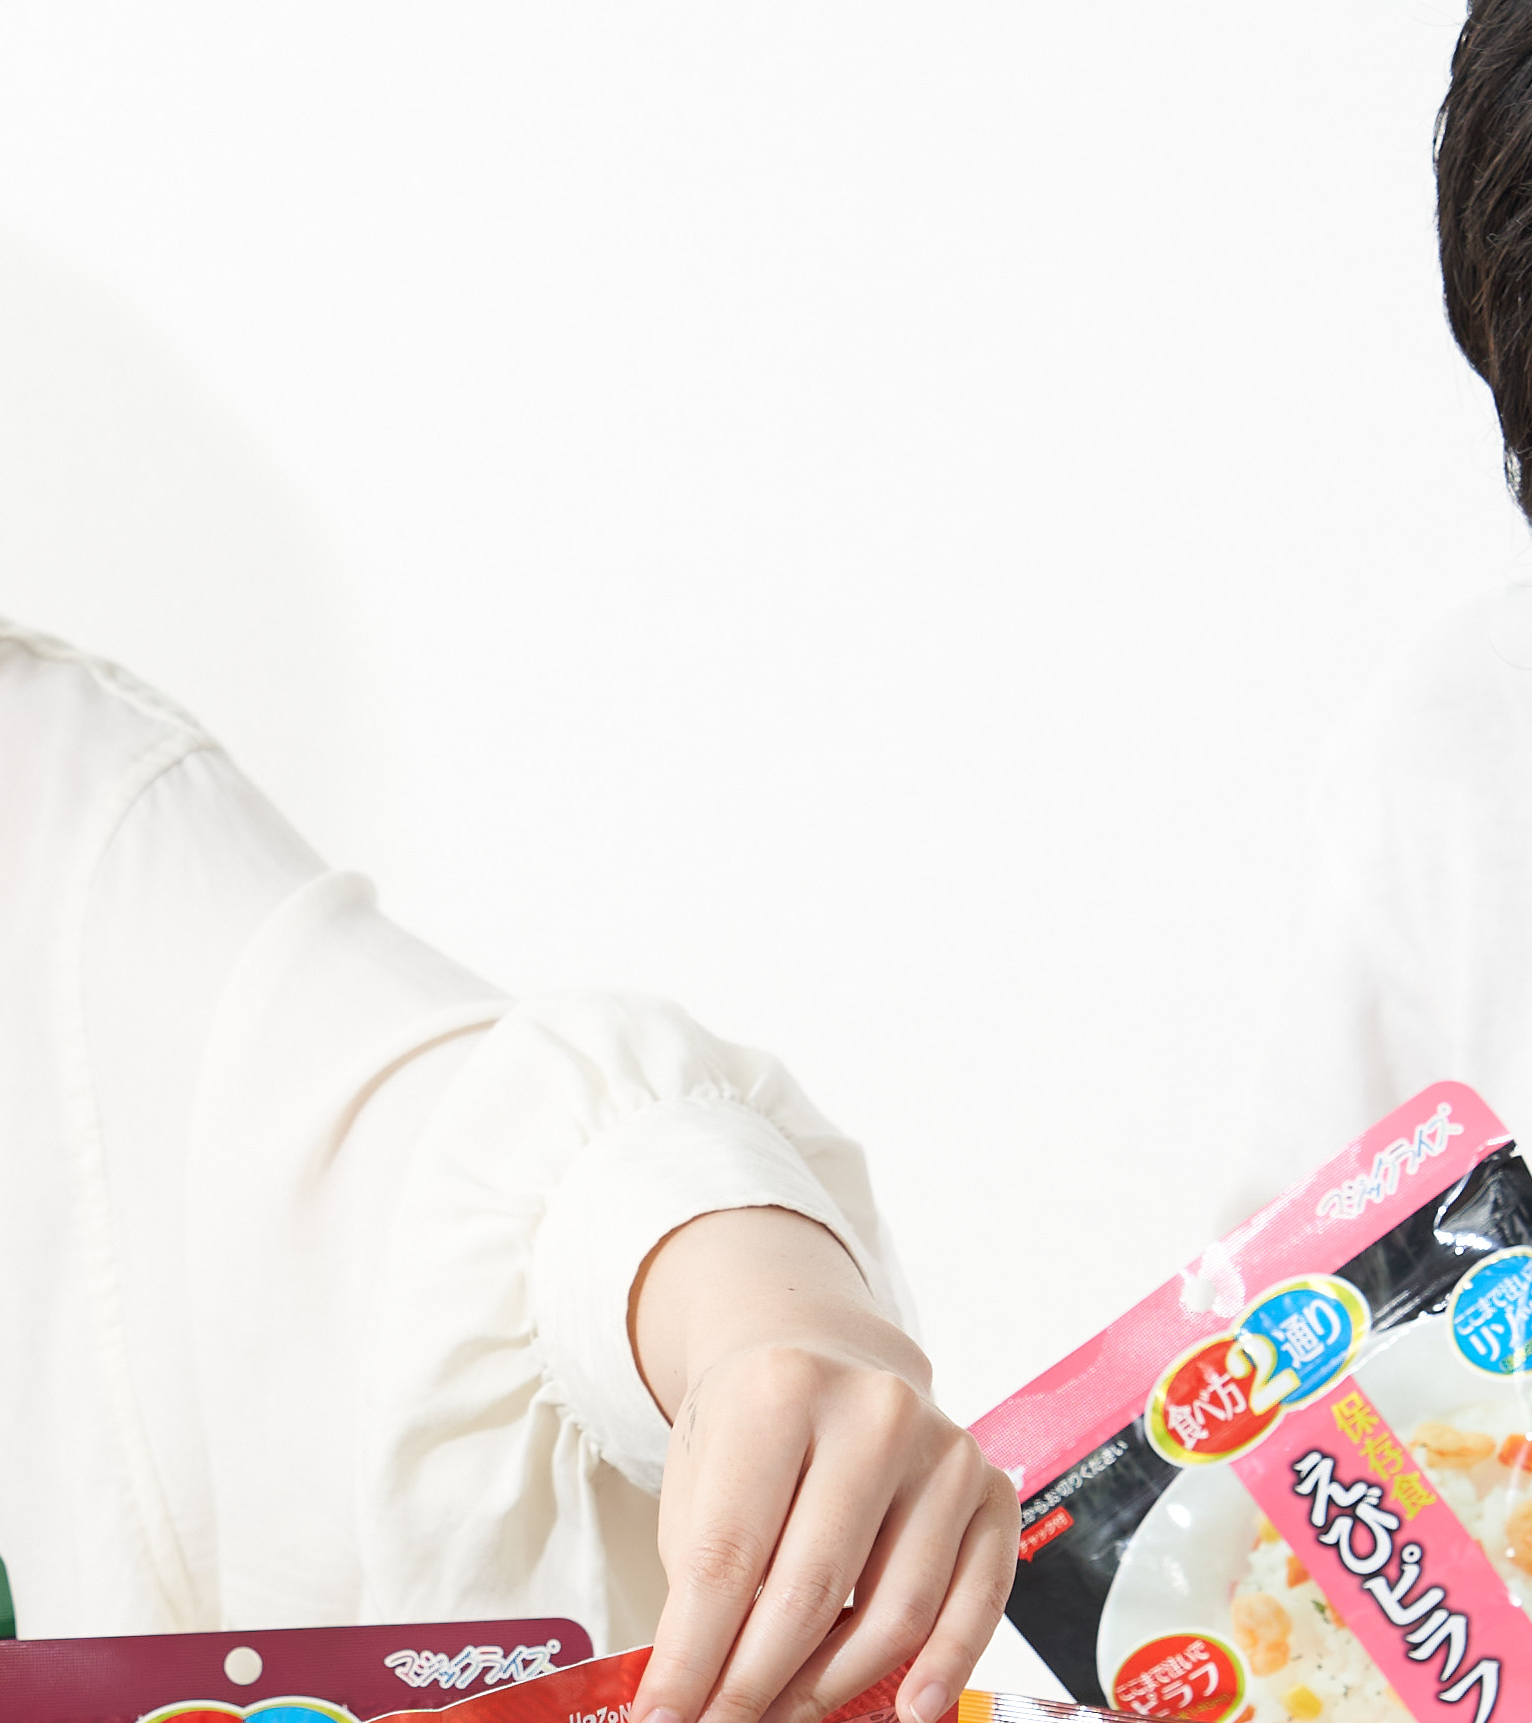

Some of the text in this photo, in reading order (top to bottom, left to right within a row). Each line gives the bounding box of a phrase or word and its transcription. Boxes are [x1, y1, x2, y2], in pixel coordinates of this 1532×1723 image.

[1166, 1298, 1342, 1452] 食べ方2通り
[1330, 1393, 1437, 1521] 保存食
[383, 1637, 562, 1690] マジックライス
